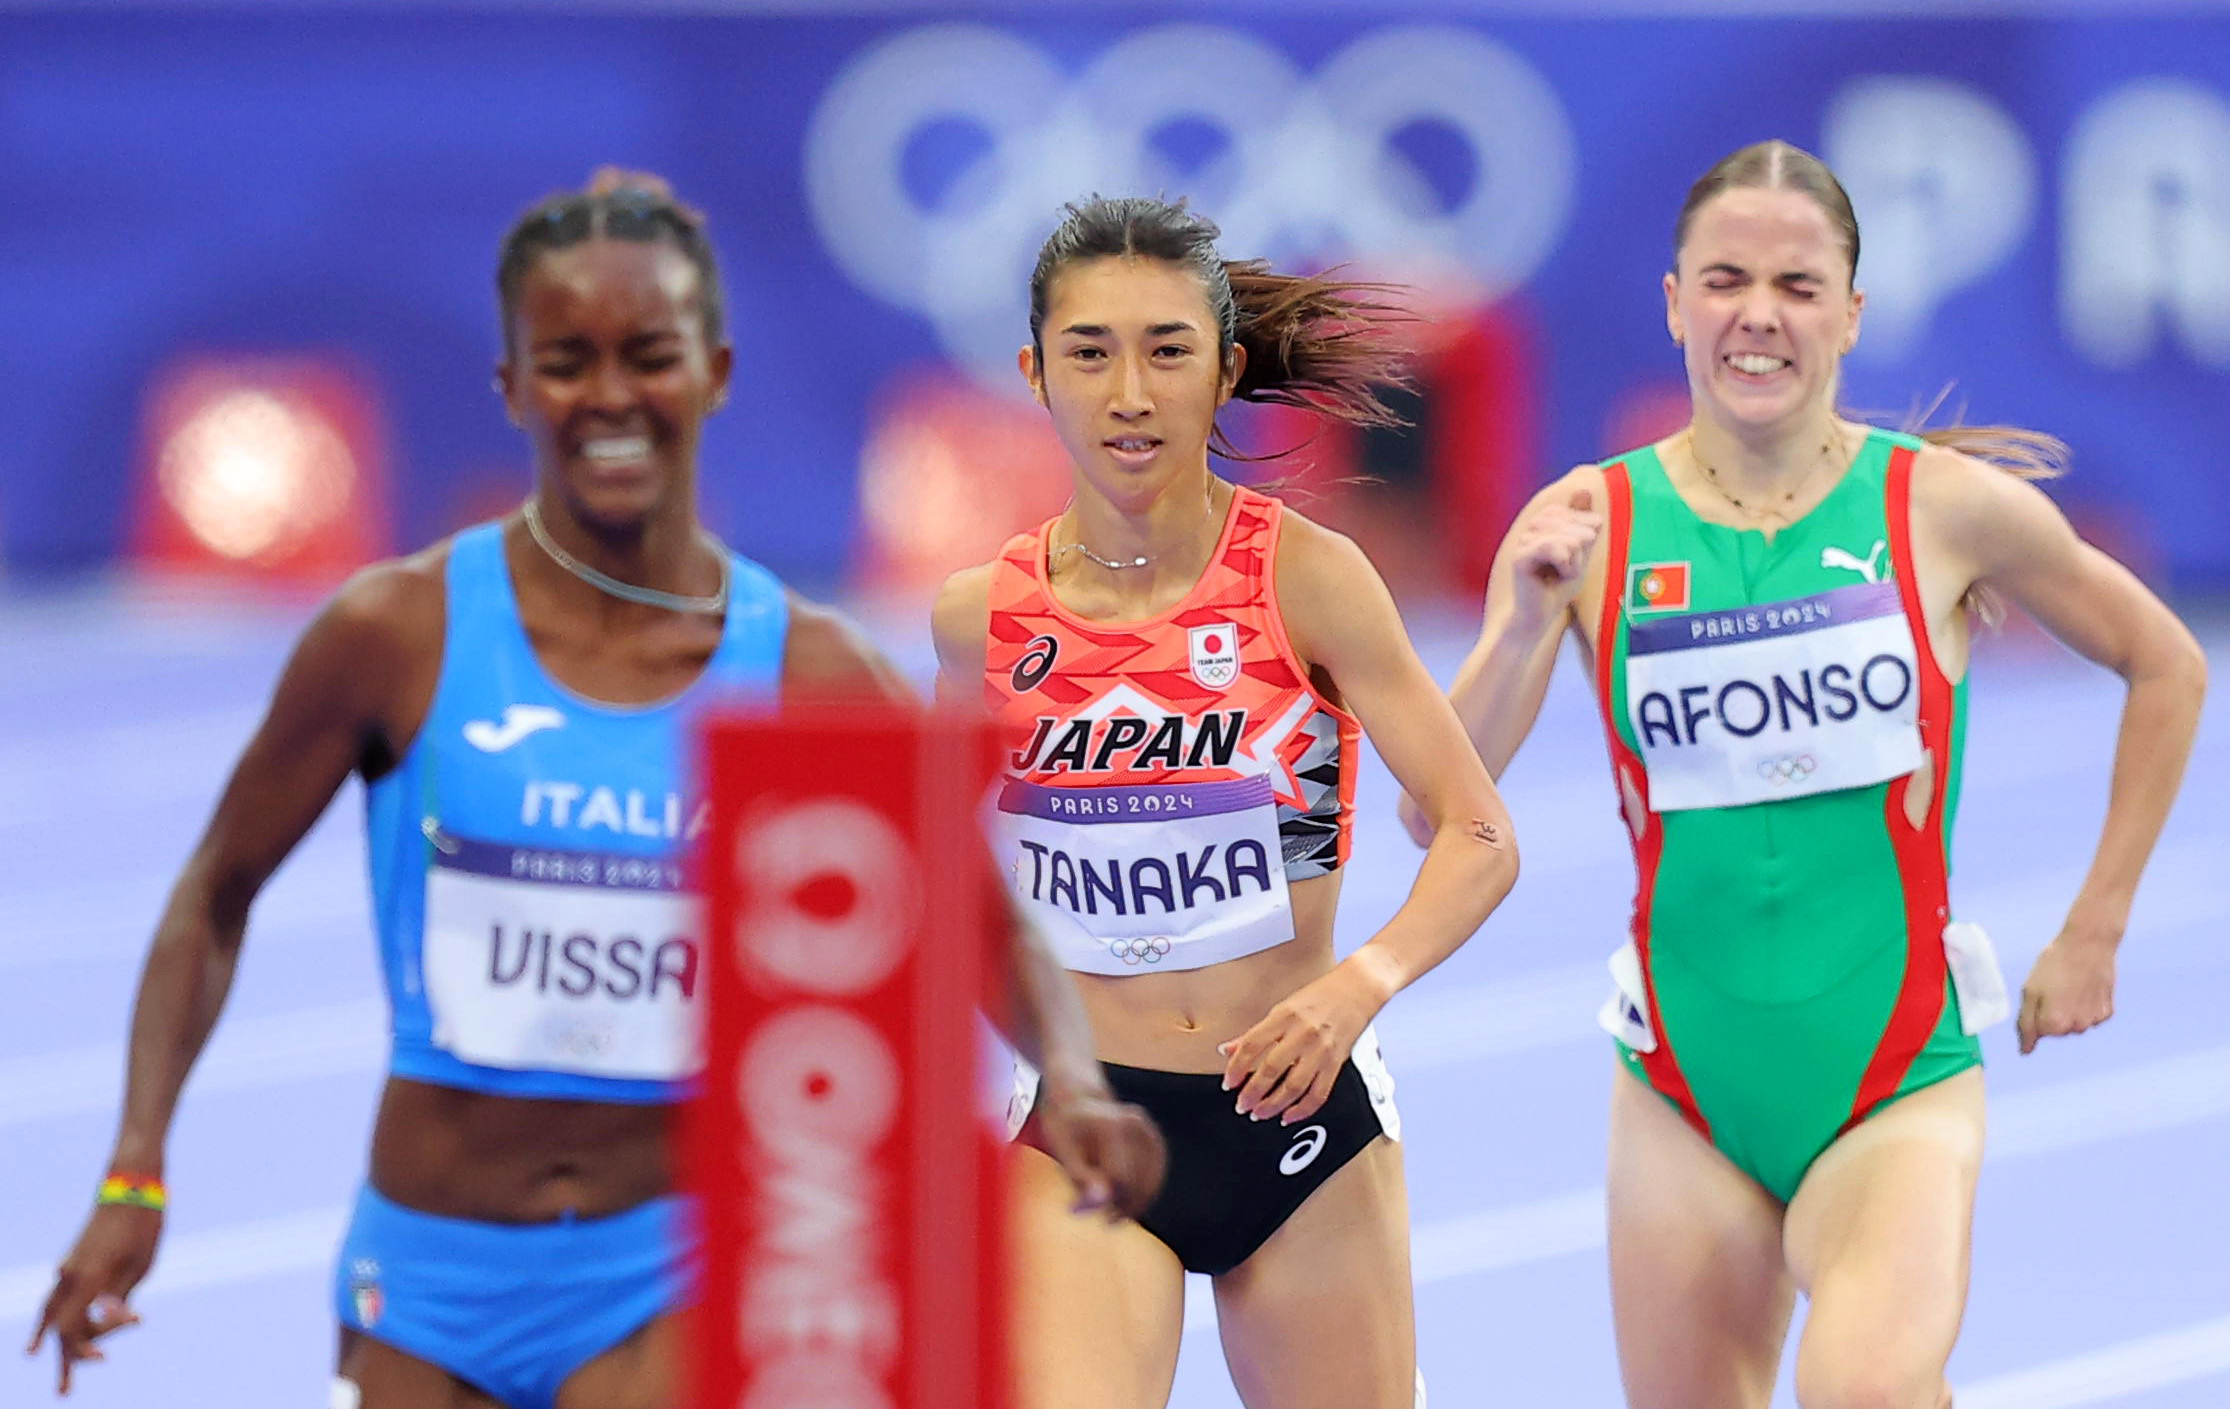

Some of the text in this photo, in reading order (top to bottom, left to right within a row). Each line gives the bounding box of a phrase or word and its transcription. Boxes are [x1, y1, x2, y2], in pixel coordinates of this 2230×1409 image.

[1690, 601, 1832, 640] PARIS 2024
[1638, 653, 1911, 748] AFONSO
[1011, 710, 1247, 773] JAPAN
[1050, 795, 1194, 814] PARIS 2024
[1019, 838, 1272, 916] TANAKA
[489, 920, 699, 1000] VISSA
